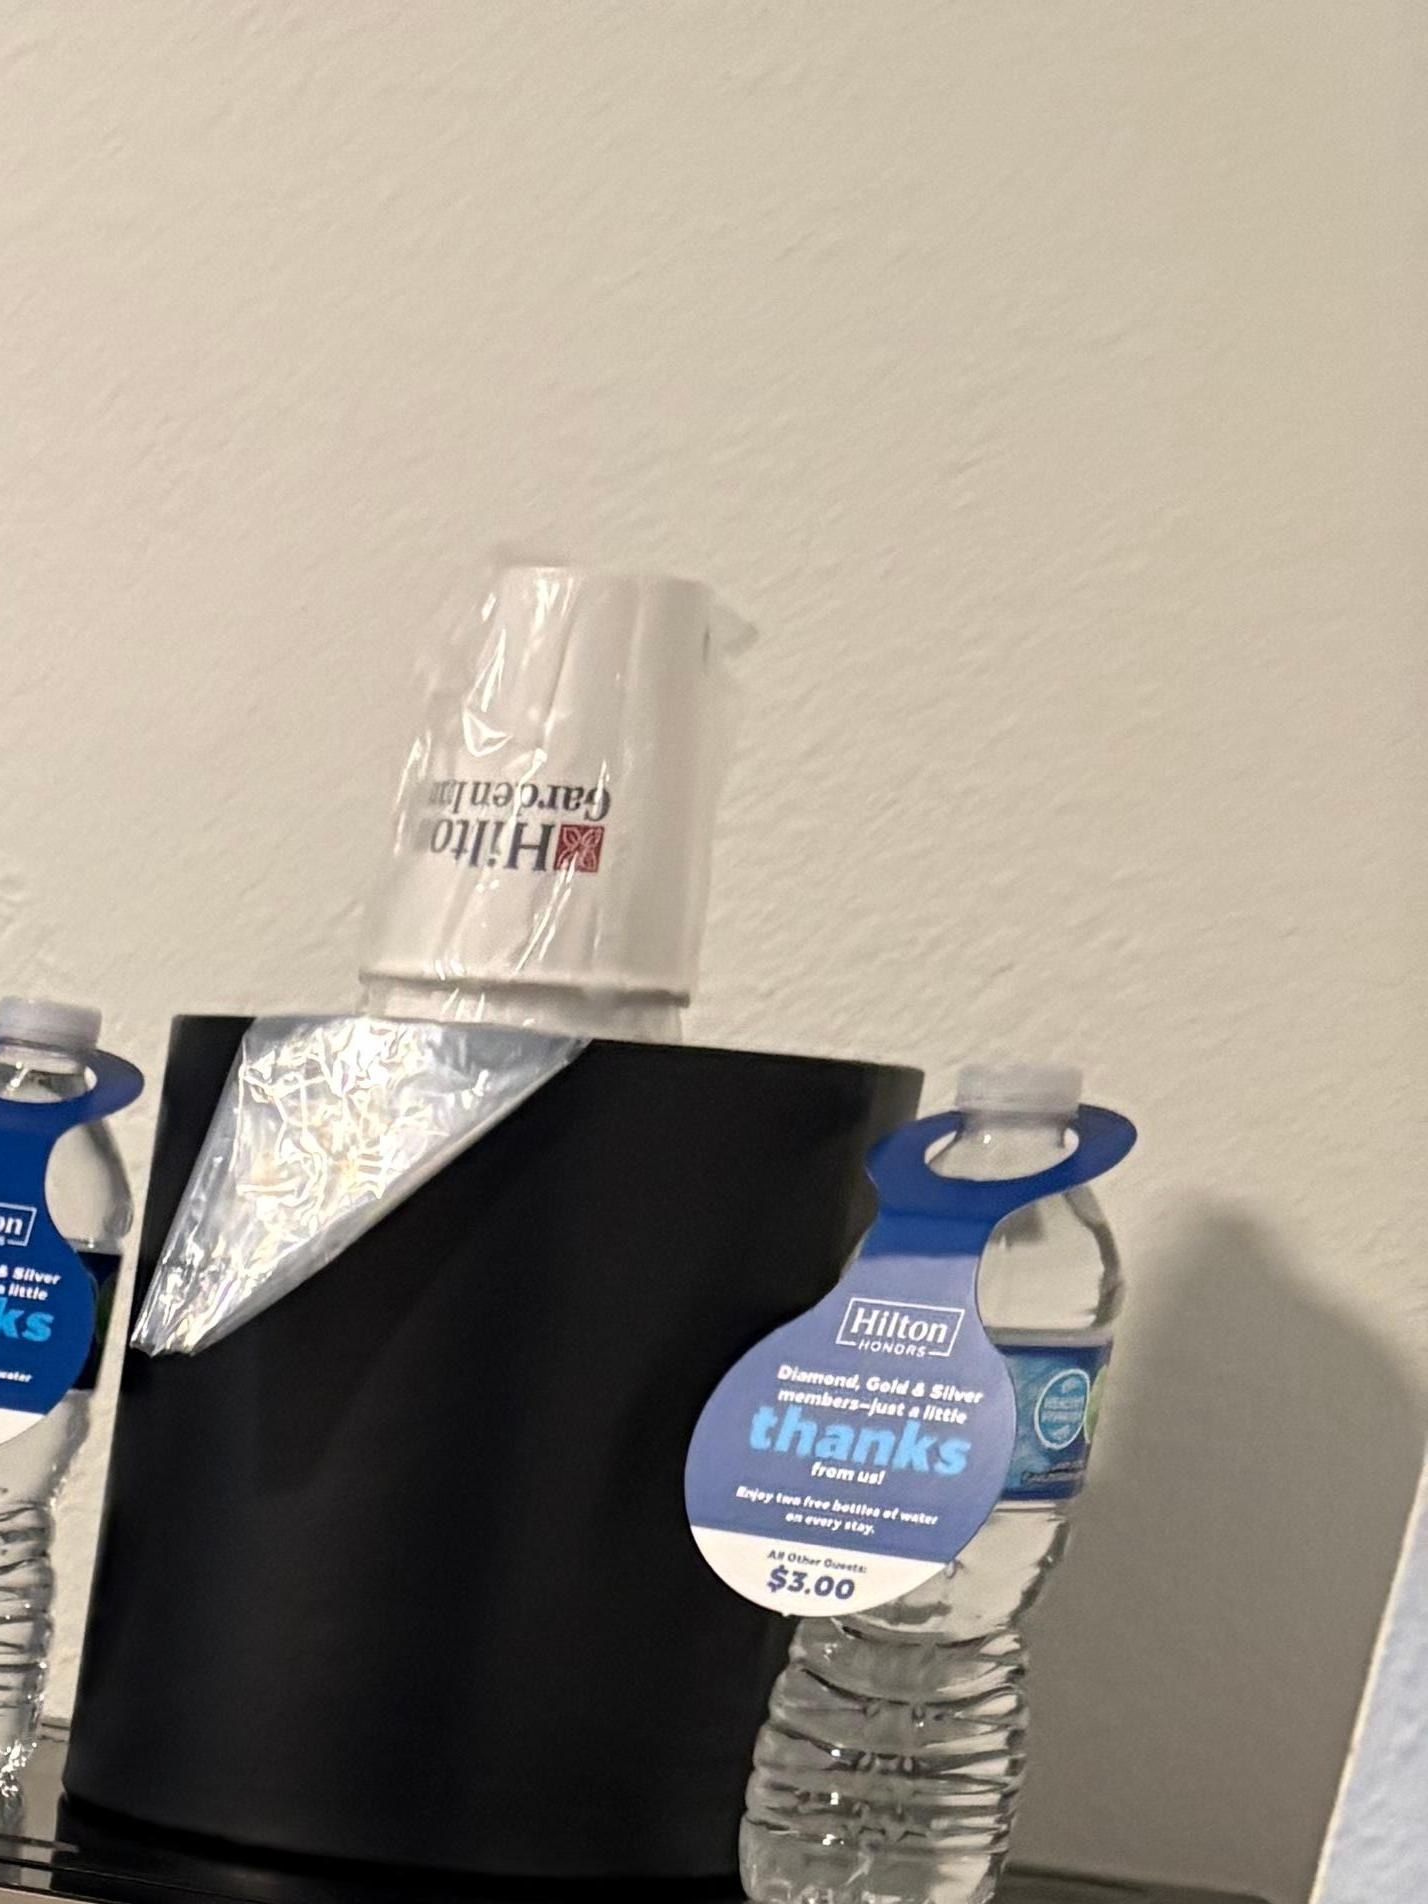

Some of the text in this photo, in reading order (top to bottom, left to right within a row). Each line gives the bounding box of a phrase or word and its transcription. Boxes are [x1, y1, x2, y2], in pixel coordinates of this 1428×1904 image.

[417, 818, 555, 872] Hilto
[12, 1266, 61, 1285] Silver
[8, 1283, 48, 1301] little
[850, 1307, 949, 1344] Hilton
[858, 1339, 926, 1358] HONORS
[777, 1364, 984, 1404] Diamond, Gold & Silver
[908, 1405, 920, 1418] a
[923, 1404, 968, 1425] little
[749, 1403, 972, 1475] thanks
[811, 1461, 886, 1485] from us!
[735, 1485, 939, 1525] Enjoy two free bottles of water
[785, 1512, 875, 1535] on every stay.
[767, 1550, 868, 1574] All Other Guests:
[766, 1565, 855, 1601] $3.00
